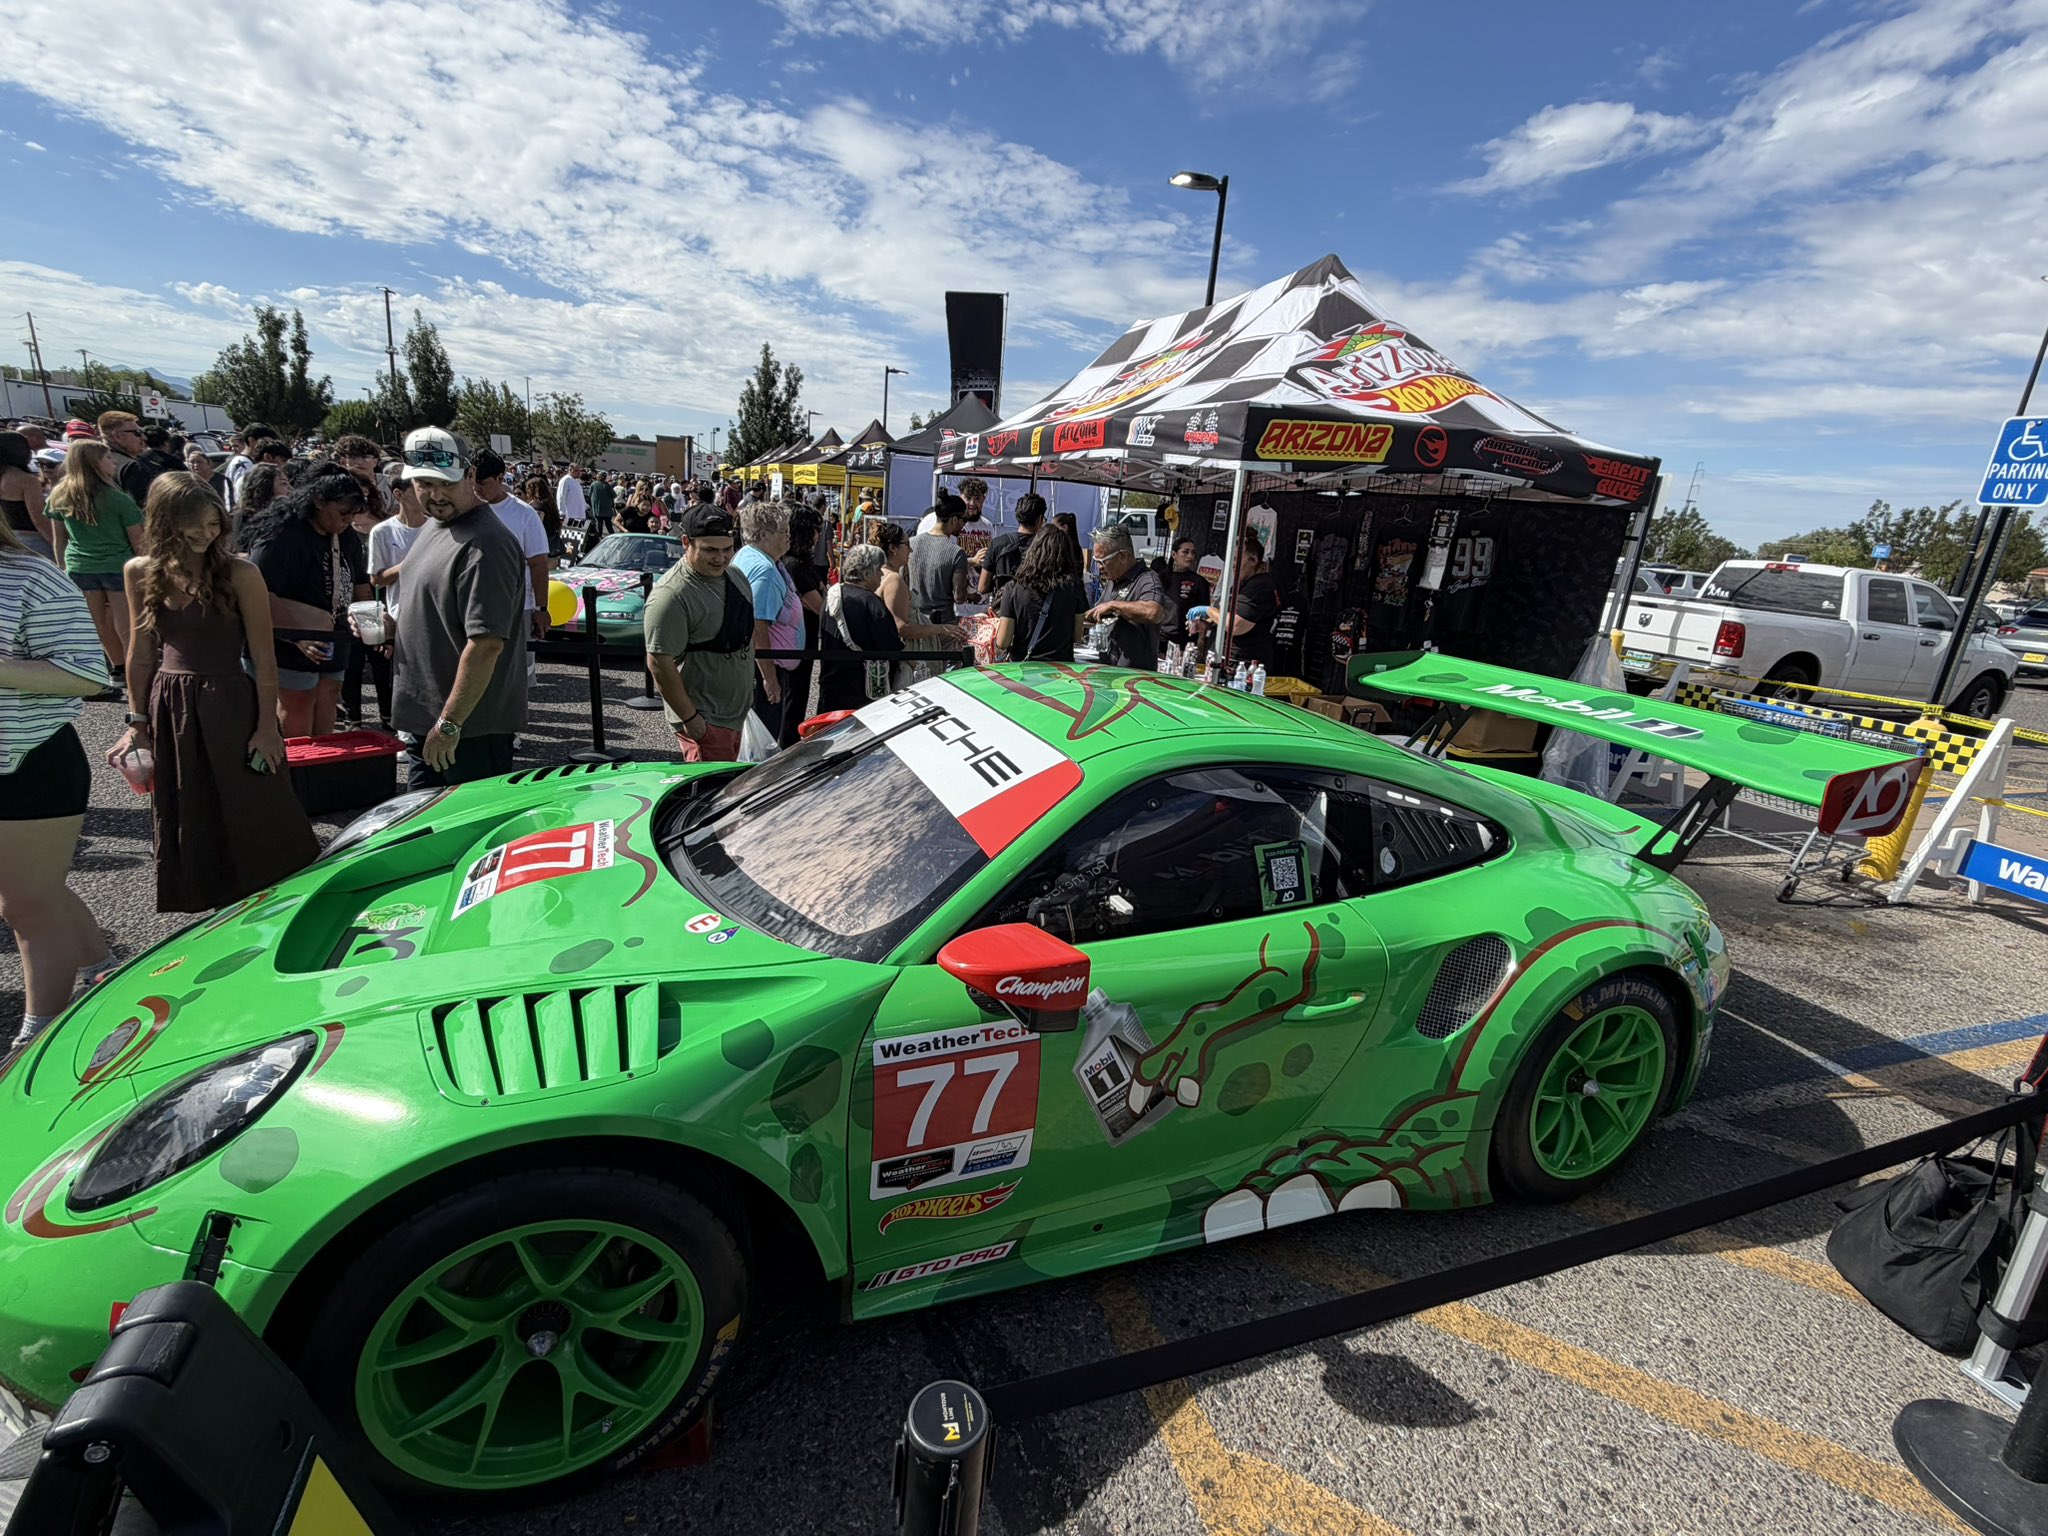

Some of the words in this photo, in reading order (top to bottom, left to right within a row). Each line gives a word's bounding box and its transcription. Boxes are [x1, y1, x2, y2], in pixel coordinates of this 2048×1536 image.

[1992, 483, 2038, 500] ONLY
[1452, 537, 1492, 578] 99
[890, 688, 1023, 788] ORCHE
[996, 976, 1086, 1000] Champion
[1083, 1051, 1115, 1078] Mobil
[1098, 1067, 1115, 1091] 1
[897, 1051, 1019, 1148] 77
[896, 1258, 951, 1281] GTD
[956, 1245, 1009, 1267] PRO
